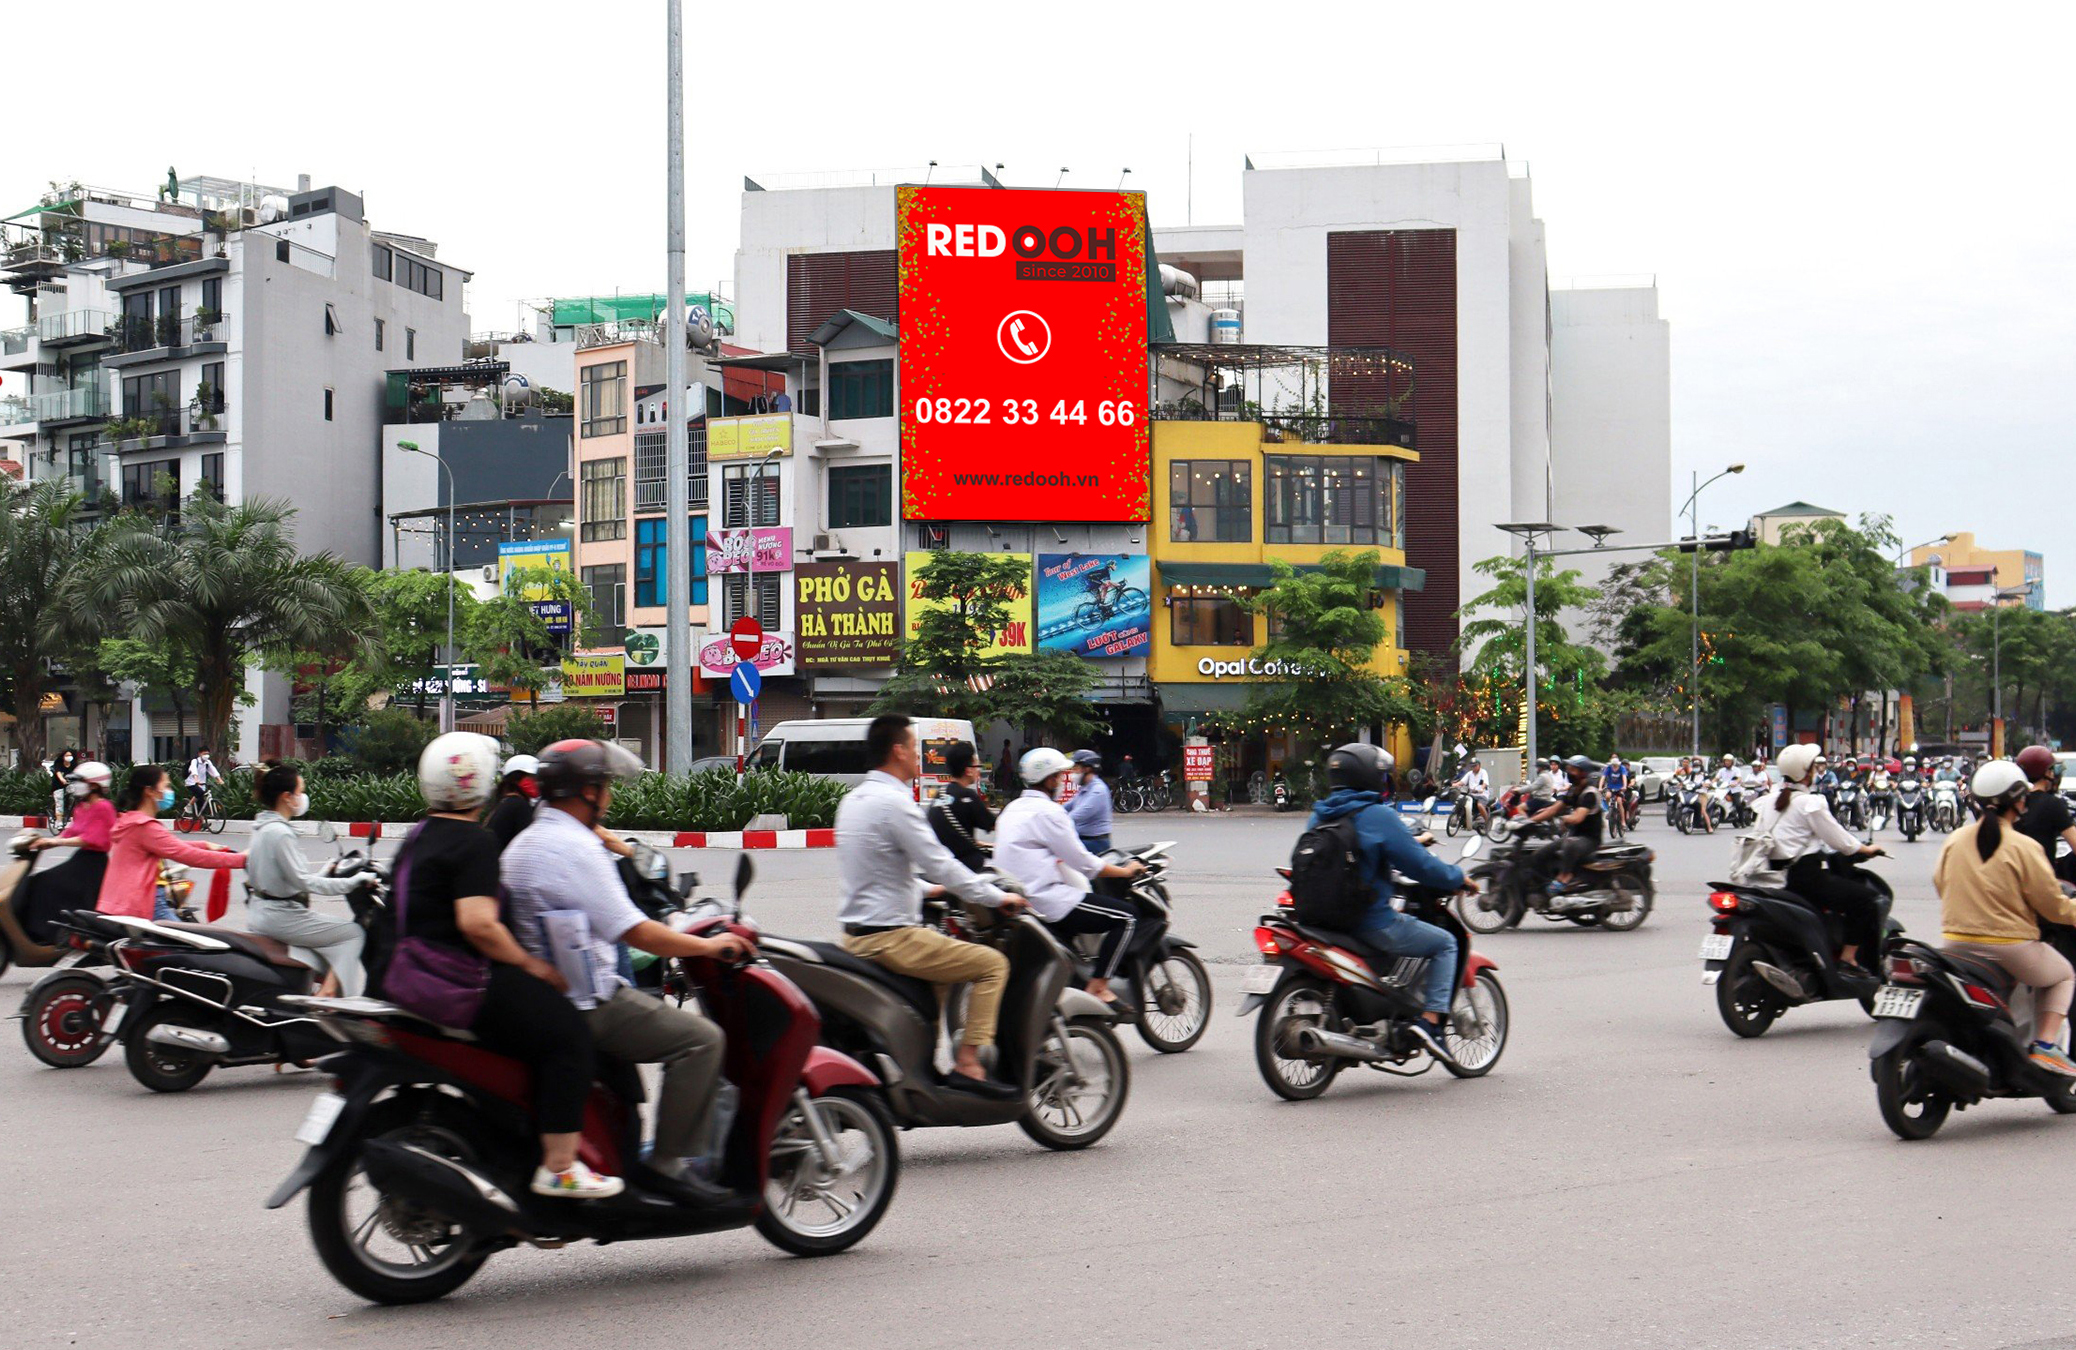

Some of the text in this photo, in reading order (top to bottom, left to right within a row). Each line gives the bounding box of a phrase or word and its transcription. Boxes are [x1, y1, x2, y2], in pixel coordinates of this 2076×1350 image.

[927, 223, 1115, 260] RED OOH
[1022, 264, 1109, 279] since 2010
[915, 397, 1135, 426] 0822 33 44 66
[953, 471, 1100, 487] www.redooh.vn
[1057, 559, 1100, 581] West Lake
[798, 566, 851, 603] PHỞ
[856, 568, 894, 602] GÀ
[800, 606, 894, 637] HÀ THÀNH
[1105, 631, 1148, 656] GALAXY
[1197, 657, 1245, 679] Opal
[1186, 756, 1212, 768] XE ĐẠP
